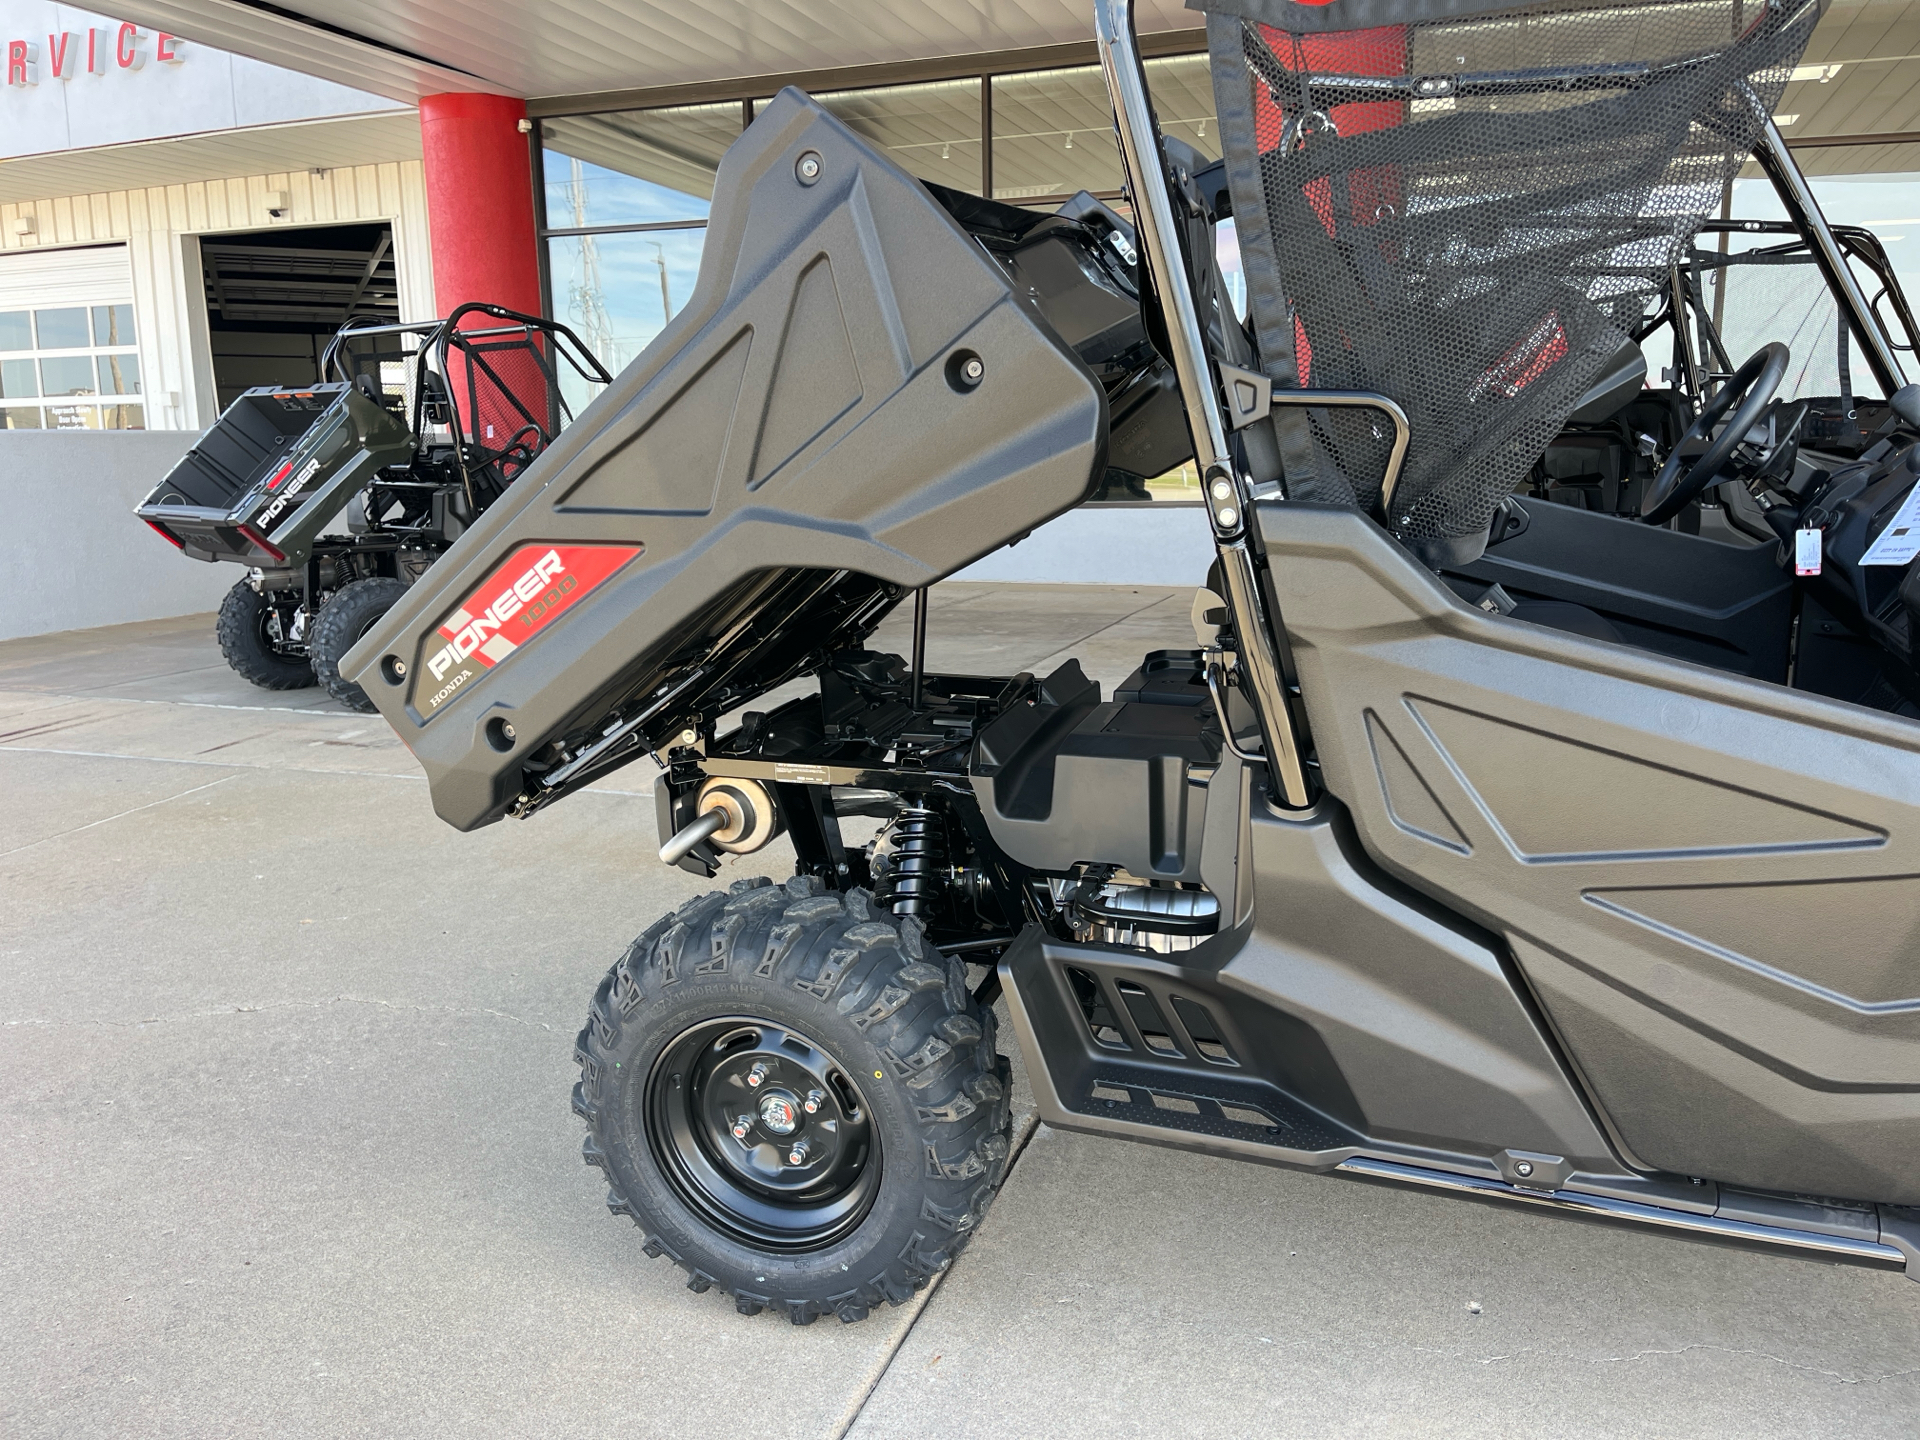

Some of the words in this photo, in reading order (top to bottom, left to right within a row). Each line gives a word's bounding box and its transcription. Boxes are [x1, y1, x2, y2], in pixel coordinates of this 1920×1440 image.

[52, 406, 75, 415] Approach
[76, 406, 92, 414] Slowly
[256, 458, 321, 529] PIONEER
[427, 549, 566, 682] PIONEER
[518, 574, 578, 628] 1000
[430, 668, 473, 708] HONDA
[730, 984, 759, 996] NHS
